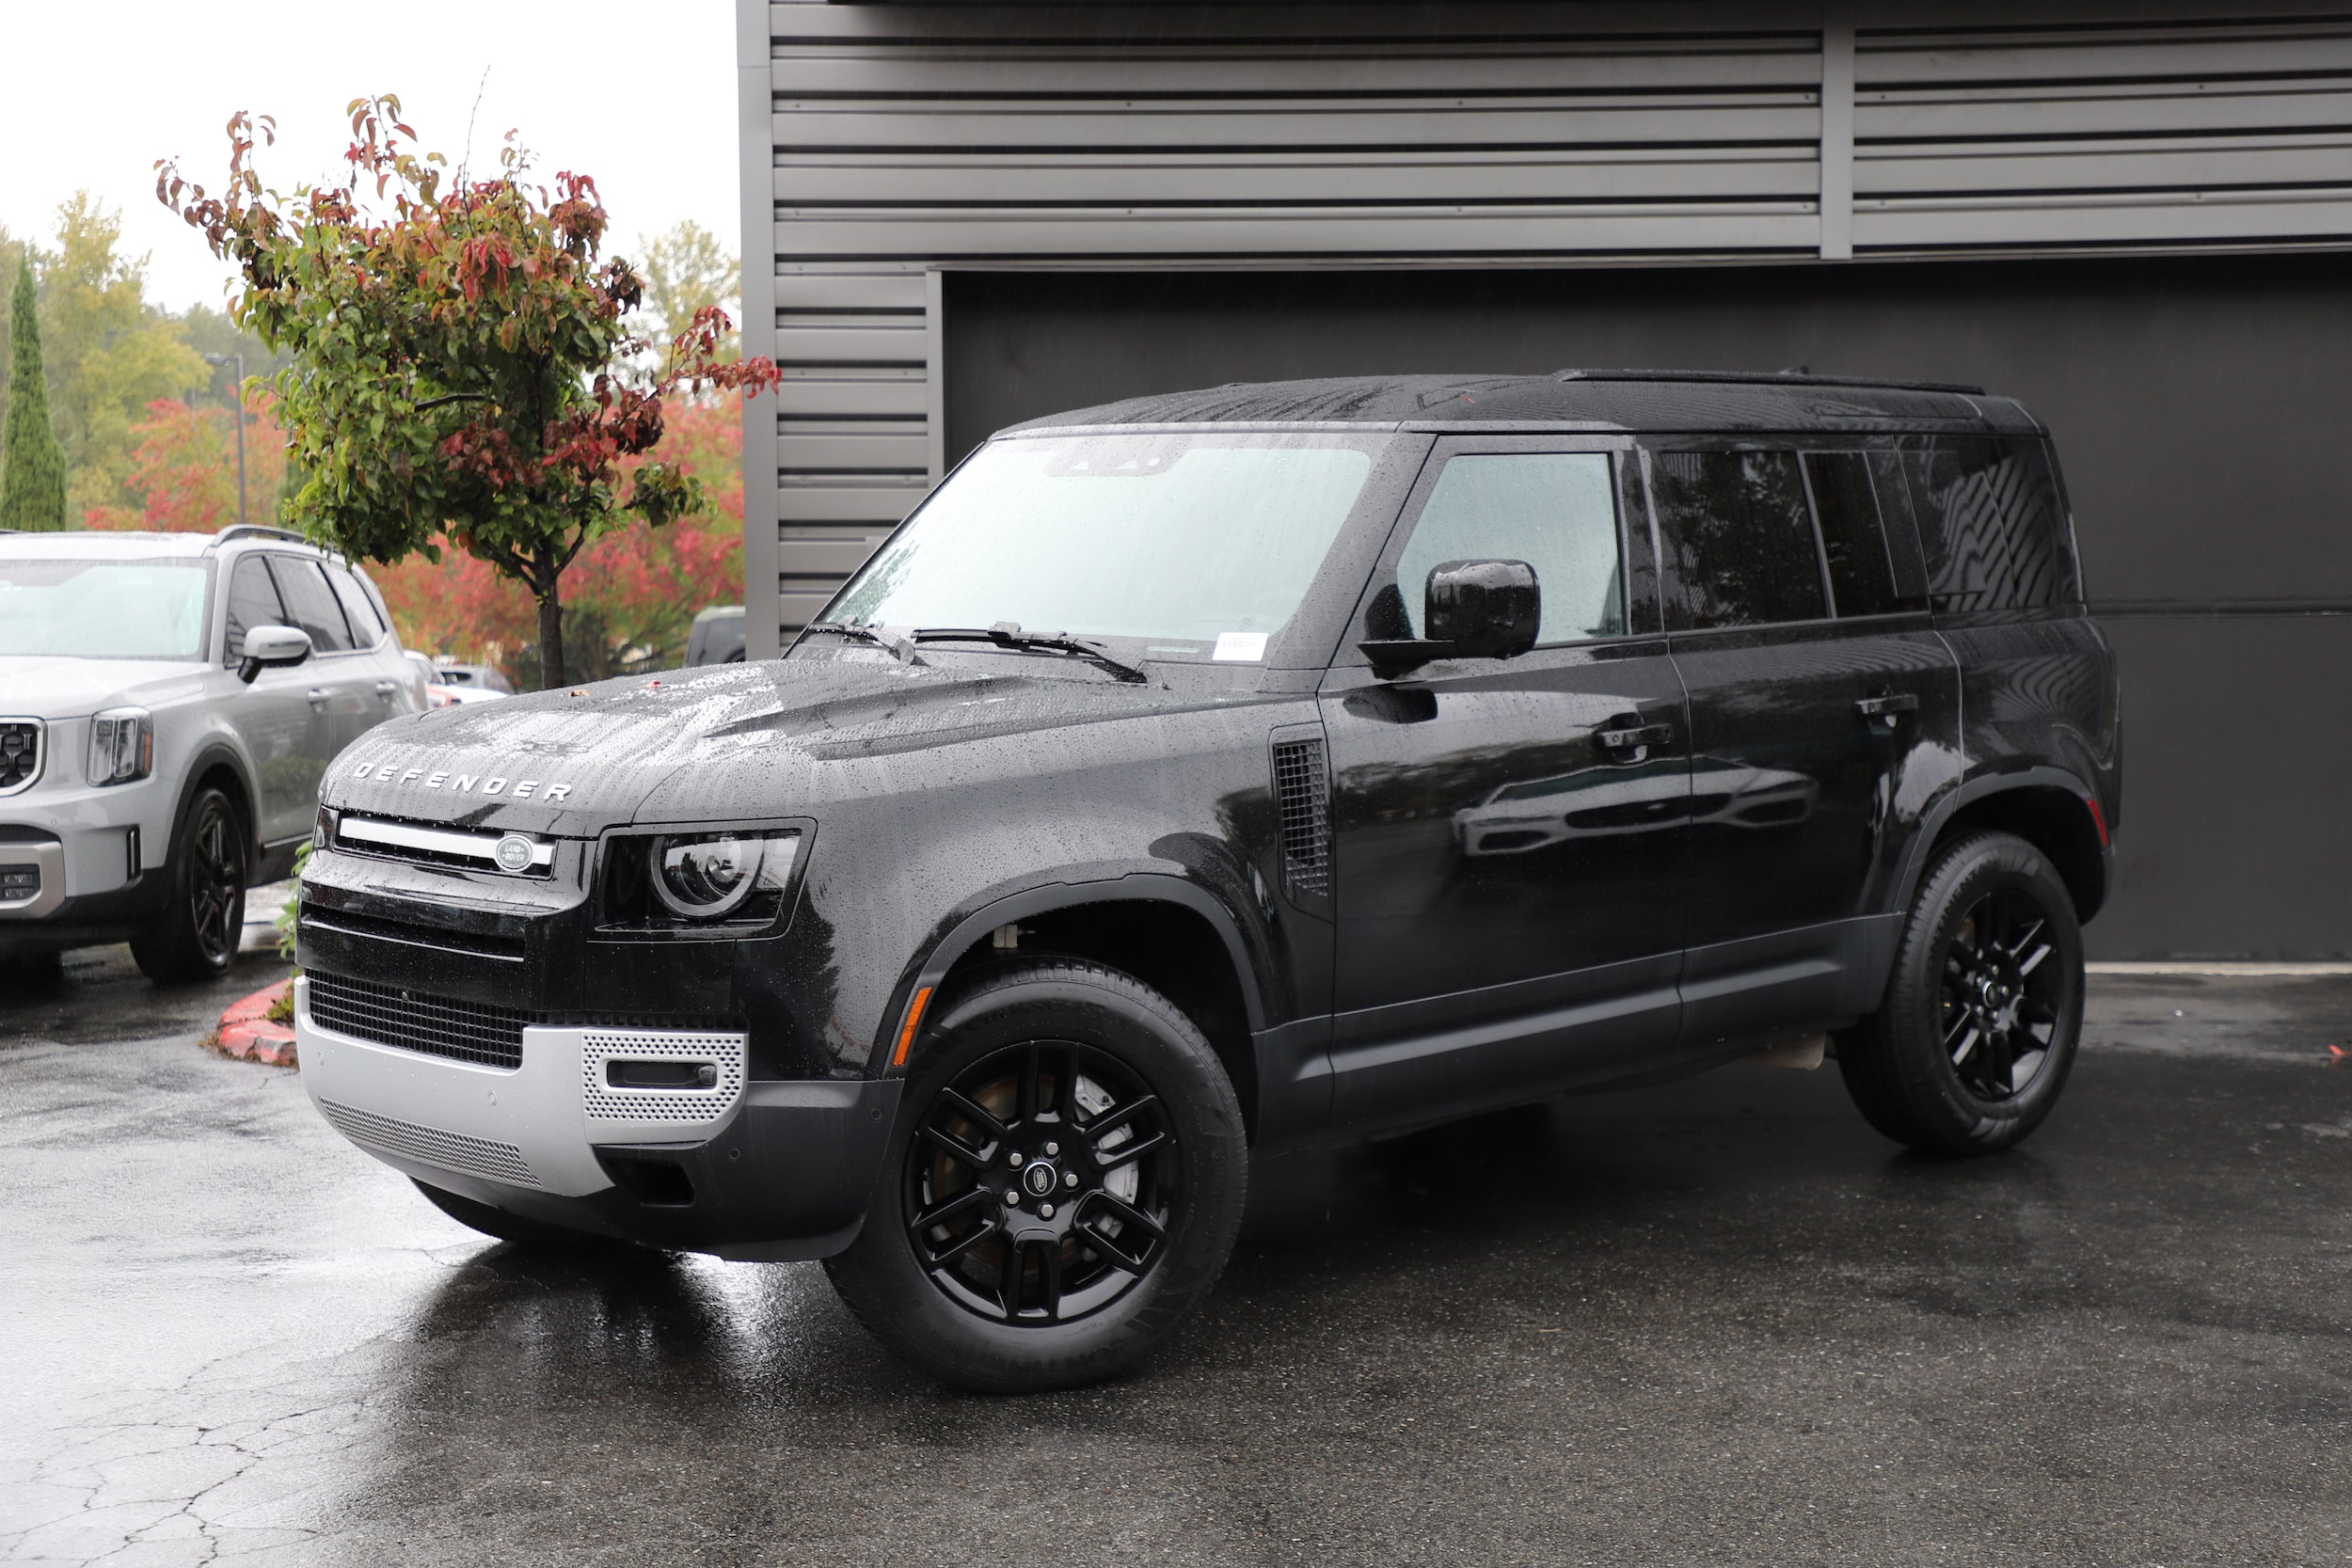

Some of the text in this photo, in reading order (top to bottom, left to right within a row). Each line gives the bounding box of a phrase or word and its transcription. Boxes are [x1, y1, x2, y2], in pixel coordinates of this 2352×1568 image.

[353, 762, 572, 801] DEFENDER
[504, 844, 521, 853] LAND
[504, 852, 525, 862] ROVER
